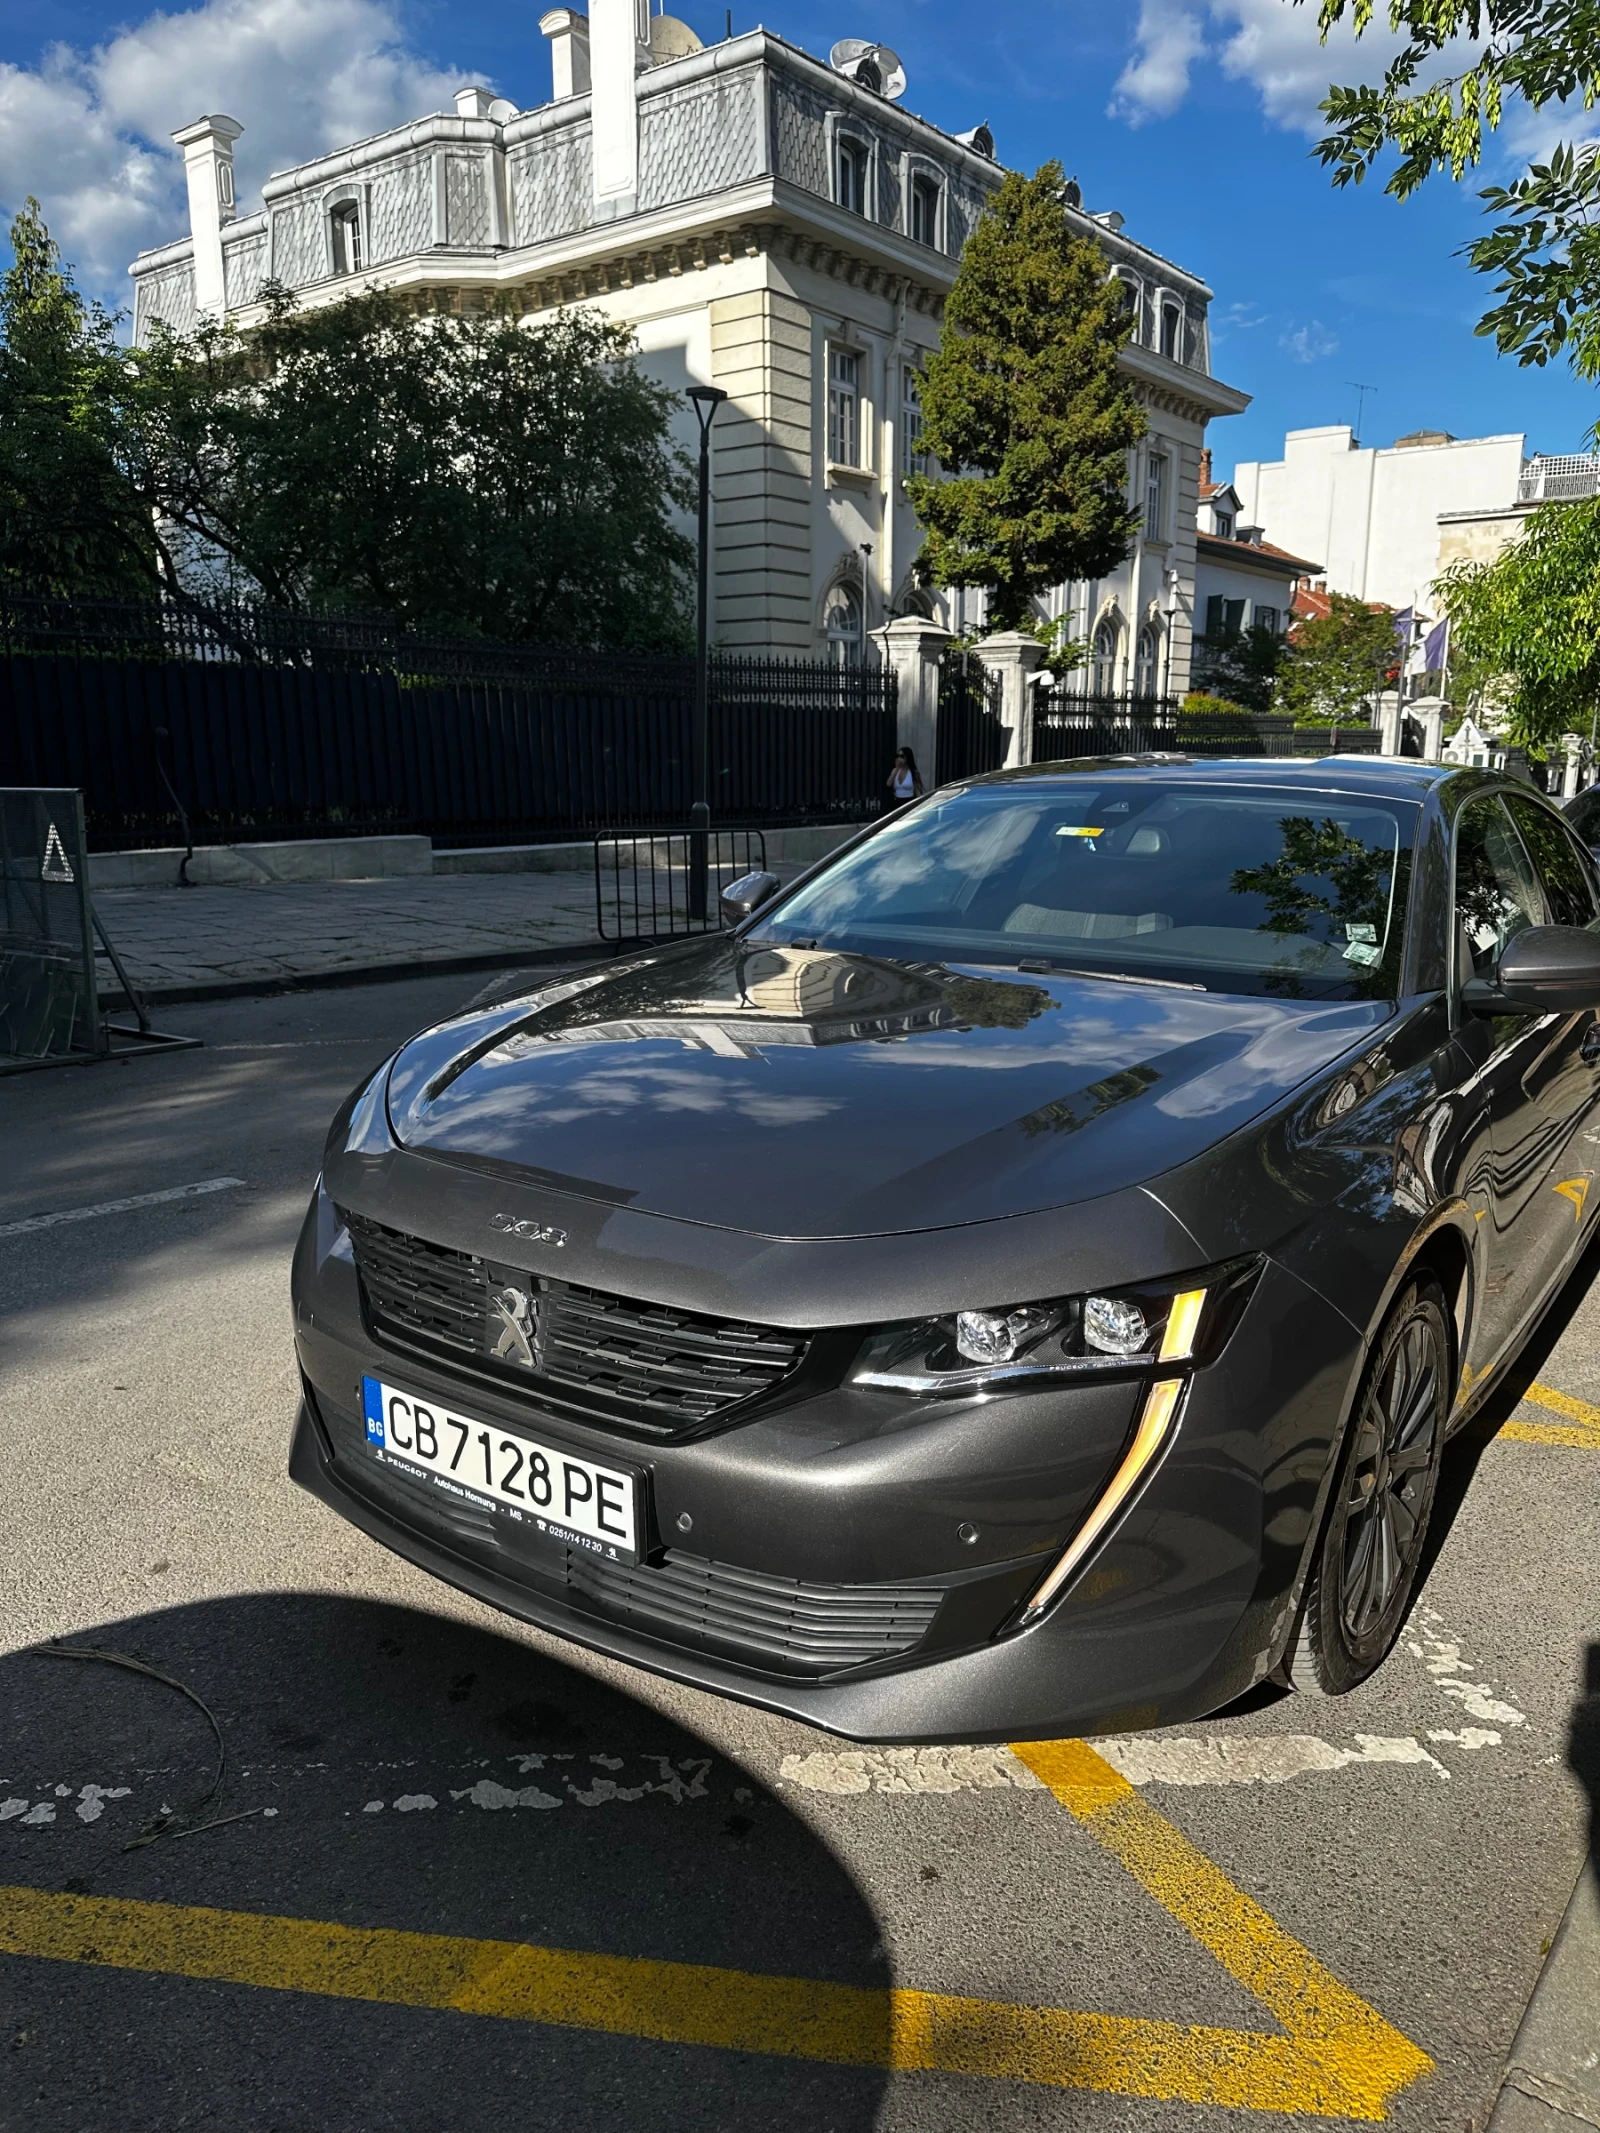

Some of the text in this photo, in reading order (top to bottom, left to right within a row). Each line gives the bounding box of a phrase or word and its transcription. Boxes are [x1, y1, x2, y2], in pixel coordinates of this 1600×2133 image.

[488, 1213, 568, 1247] 508
[367, 1417, 384, 1437] BG
[387, 1456, 428, 1479] PEUGEOT
[433, 1475, 464, 1497] Autohaus
[464, 1489, 497, 1512] Hornung
[509, 1507, 523, 1521] MS
[389, 1396, 627, 1540] CB 7128 PE
